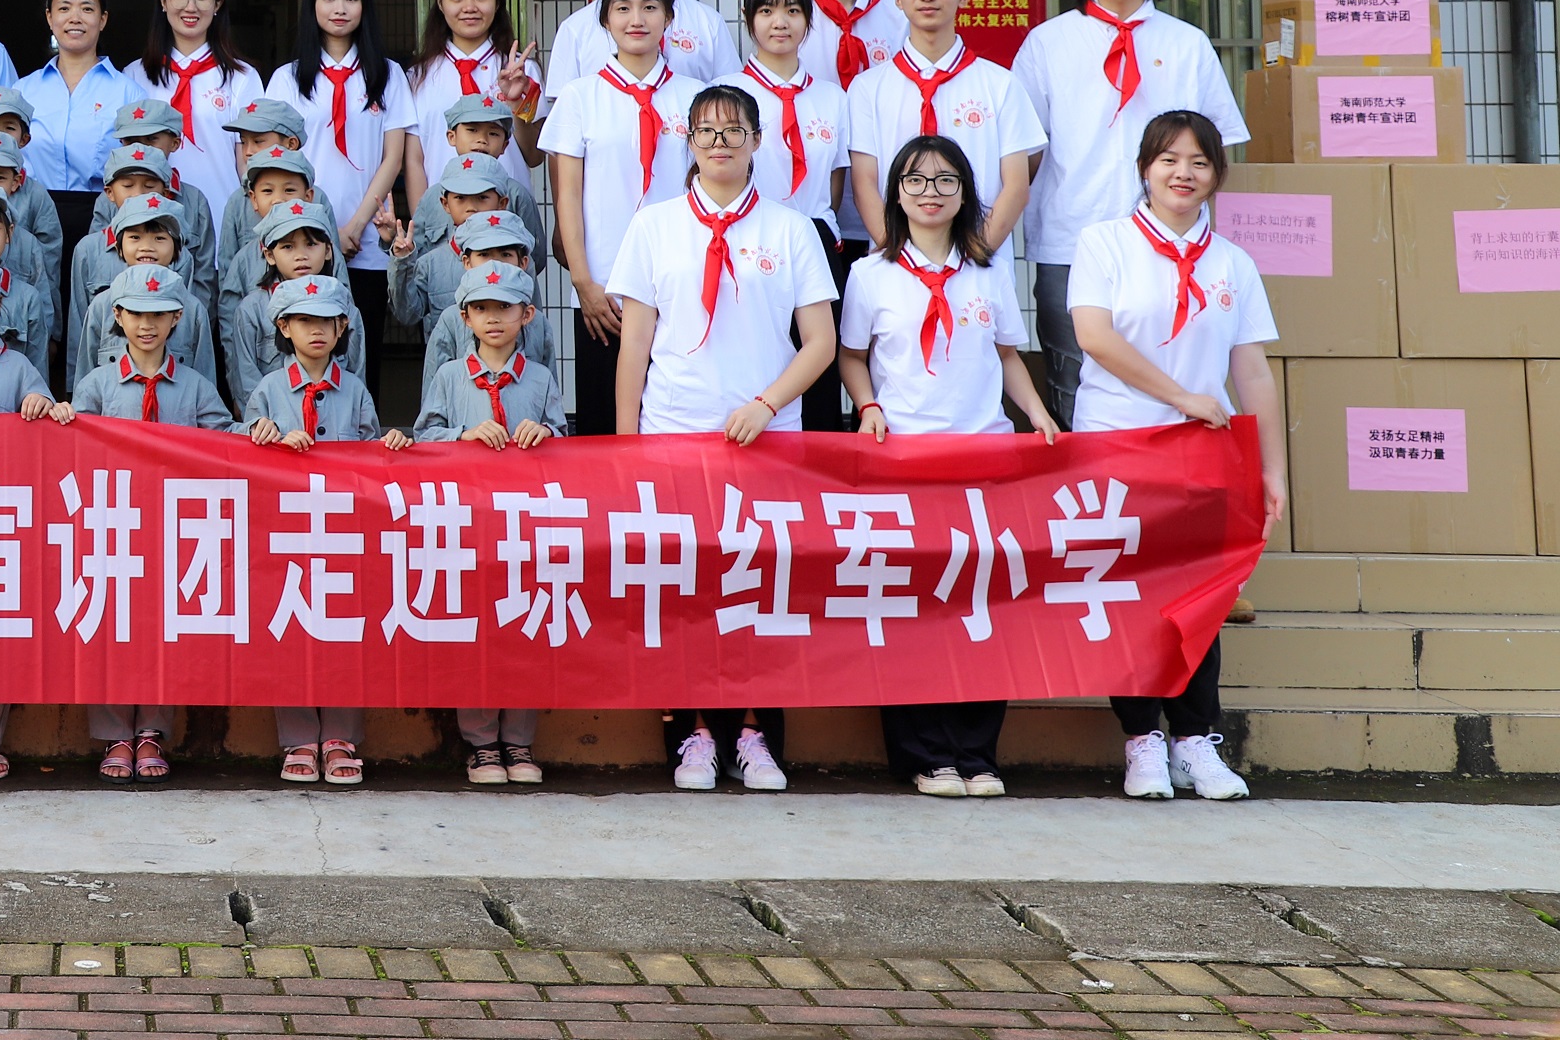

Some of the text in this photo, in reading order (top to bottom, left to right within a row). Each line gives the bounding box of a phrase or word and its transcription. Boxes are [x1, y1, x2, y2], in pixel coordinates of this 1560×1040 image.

[1326, 10, 1410, 22] 榕树青年宣讲团
[1340, 98, 1406, 108] 海南师范大学
[1330, 112, 1416, 124] 榕树青年宣讲团
[1230, 213, 1316, 228] 背上求知的行囊
[1230, 230, 1316, 244] 奔向知识的海洋
[1470, 230, 1560, 244] 背上求知的行囊
[1474, 248, 1560, 261] 奔向知识的海洋
[1369, 430, 1445, 443] 发扬女足精神
[1369, 446, 1446, 460] 汲取青春力量
[1180, 760, 1192, 774] N
